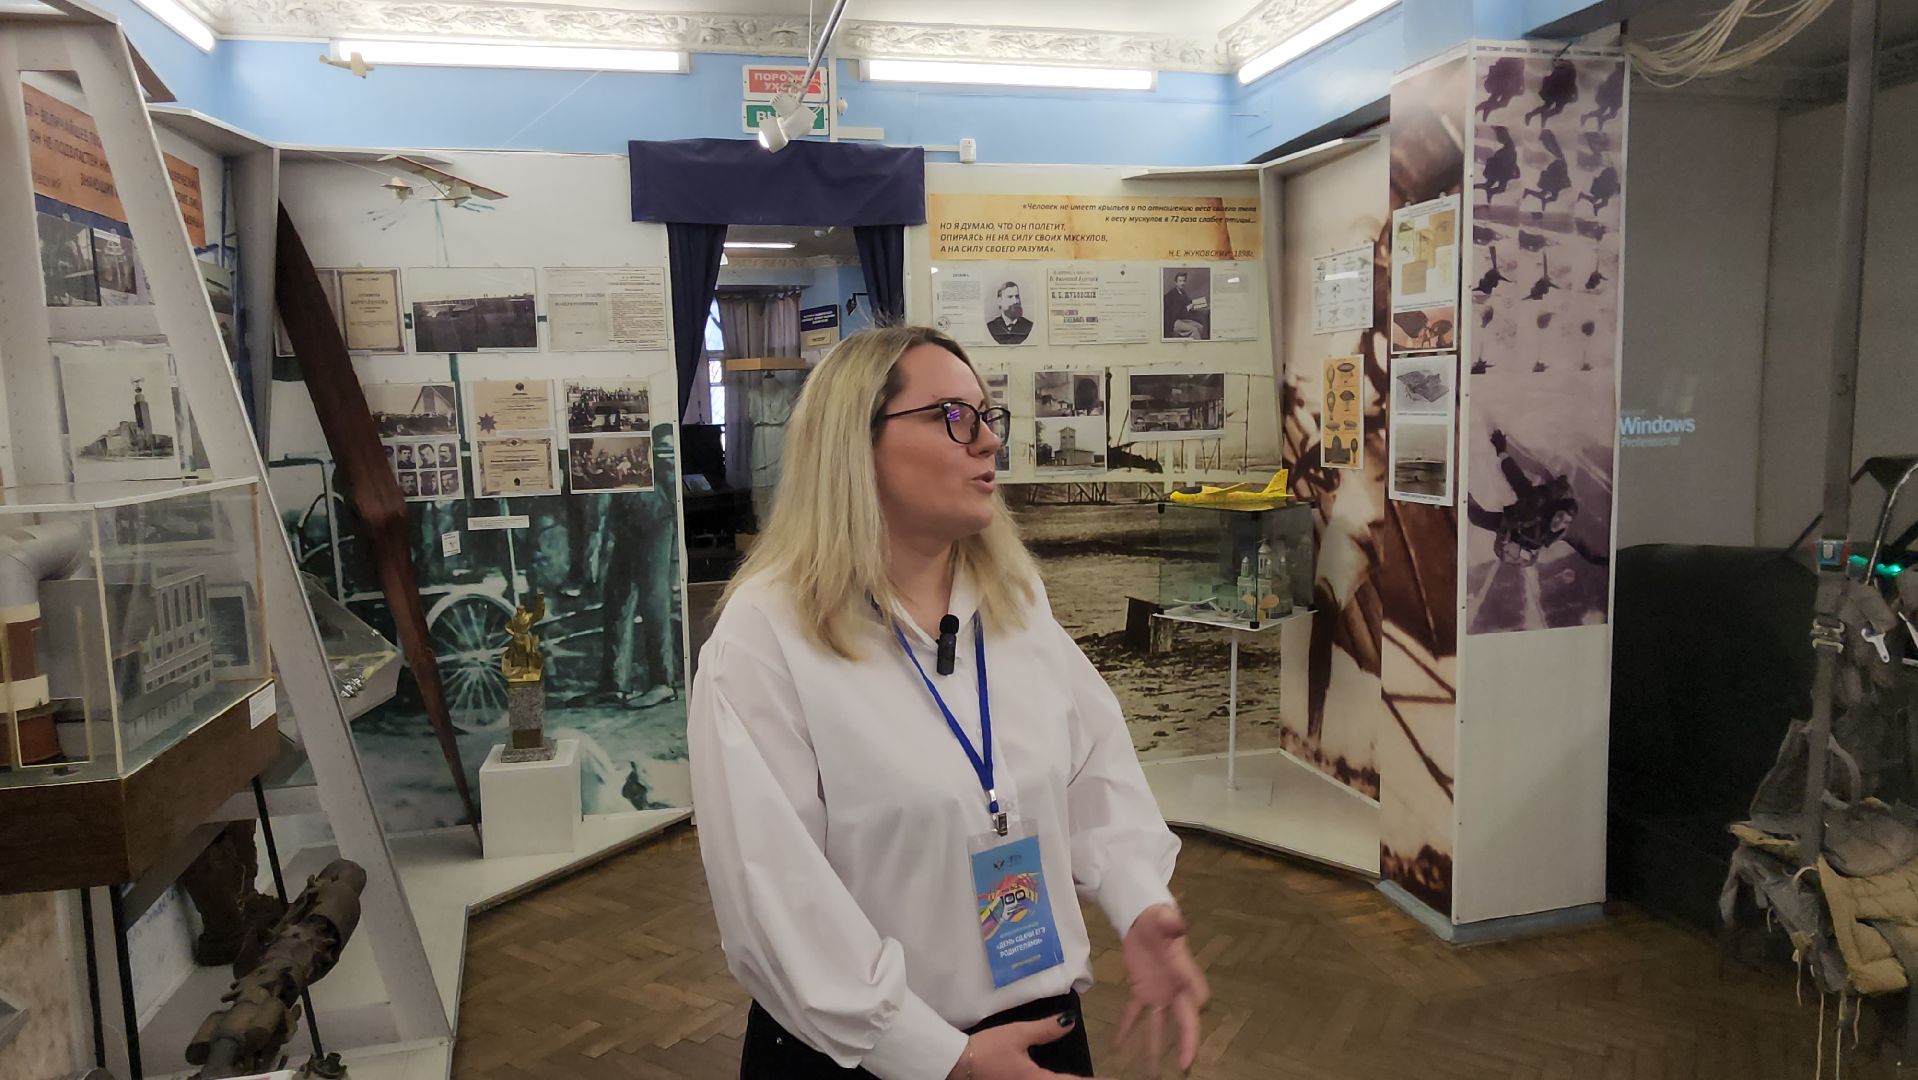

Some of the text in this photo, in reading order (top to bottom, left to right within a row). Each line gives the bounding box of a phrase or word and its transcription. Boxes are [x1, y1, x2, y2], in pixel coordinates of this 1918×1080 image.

[1111, 216, 1127, 224] весу
[1129, 216, 1162, 224] мускулов
[1180, 216, 1197, 224] раза
[961, 223, 995, 231] ДУМАЮ,
[1029, 223, 1066, 231] ПОЛЕТИТ,
[1620, 415, 1696, 435] Windows
[1000, 889, 1026, 907] 100
